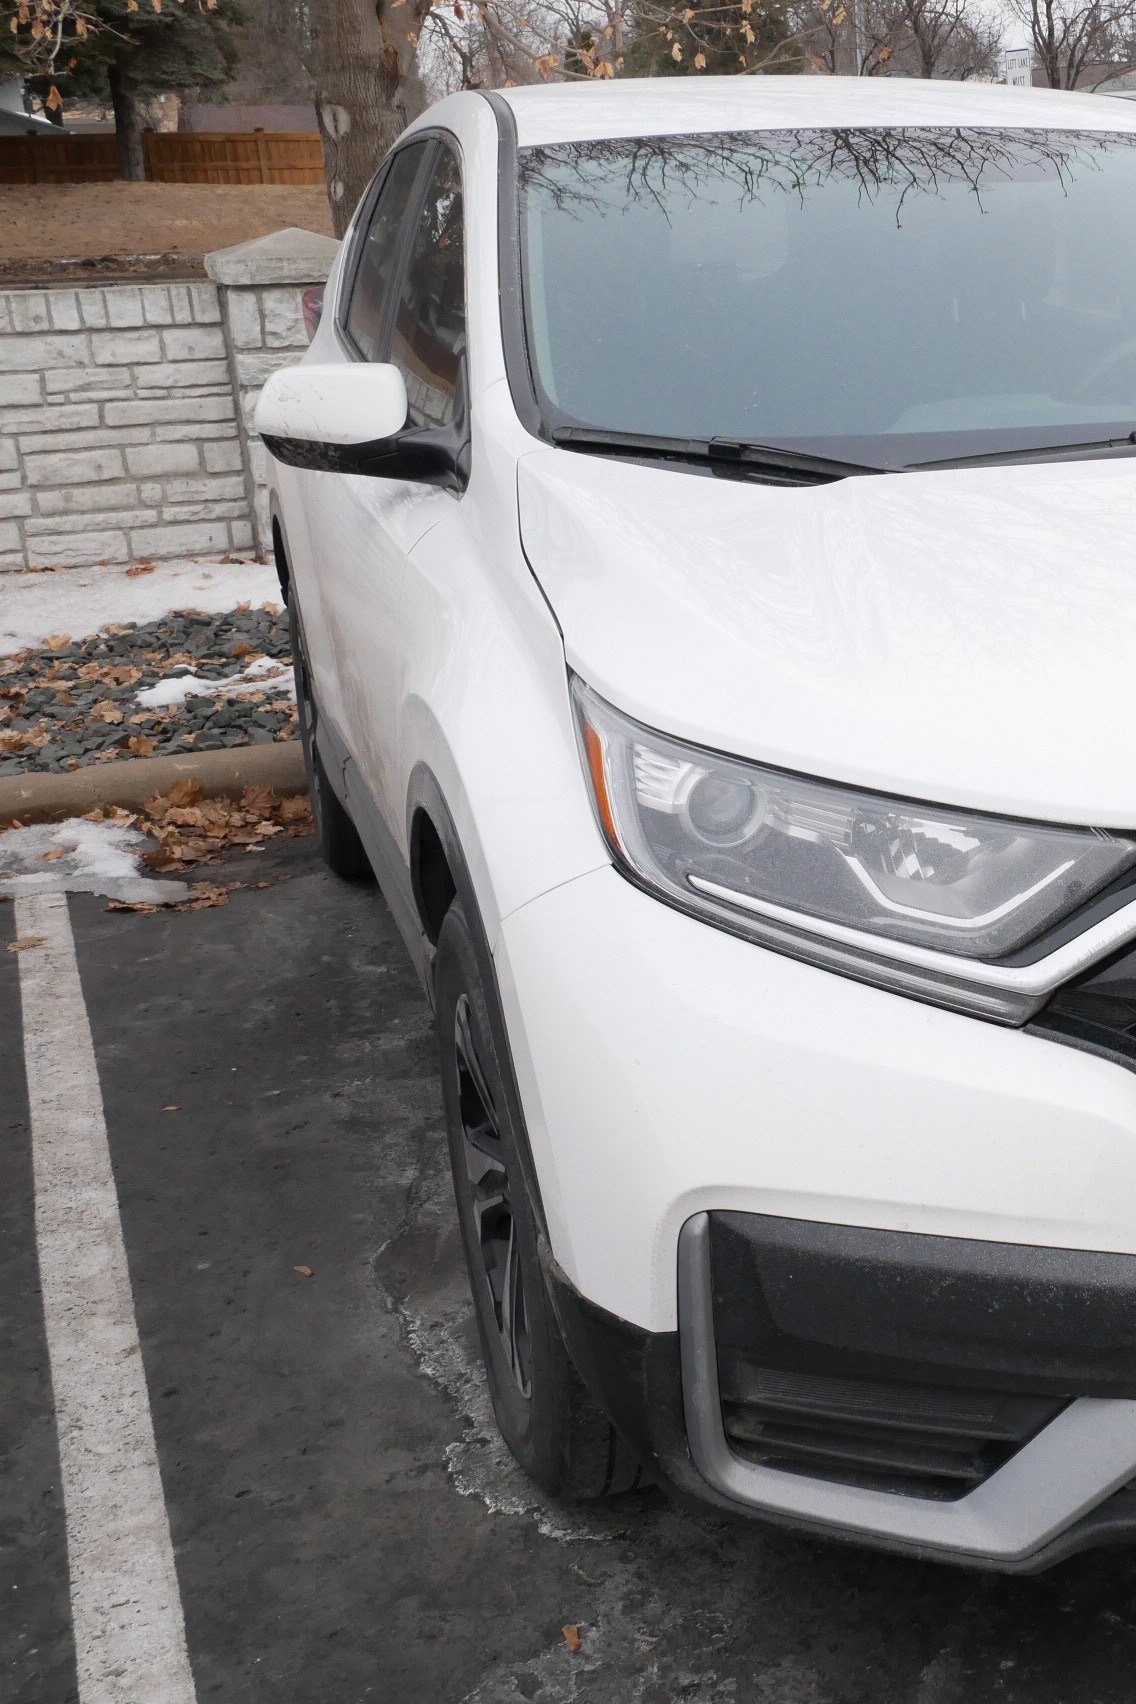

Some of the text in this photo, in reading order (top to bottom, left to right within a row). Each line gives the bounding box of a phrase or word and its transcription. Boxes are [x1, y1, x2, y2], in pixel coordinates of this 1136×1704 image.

[1008, 57, 1028, 69] LEFT LANE
[1012, 75, 1025, 86] MUST
